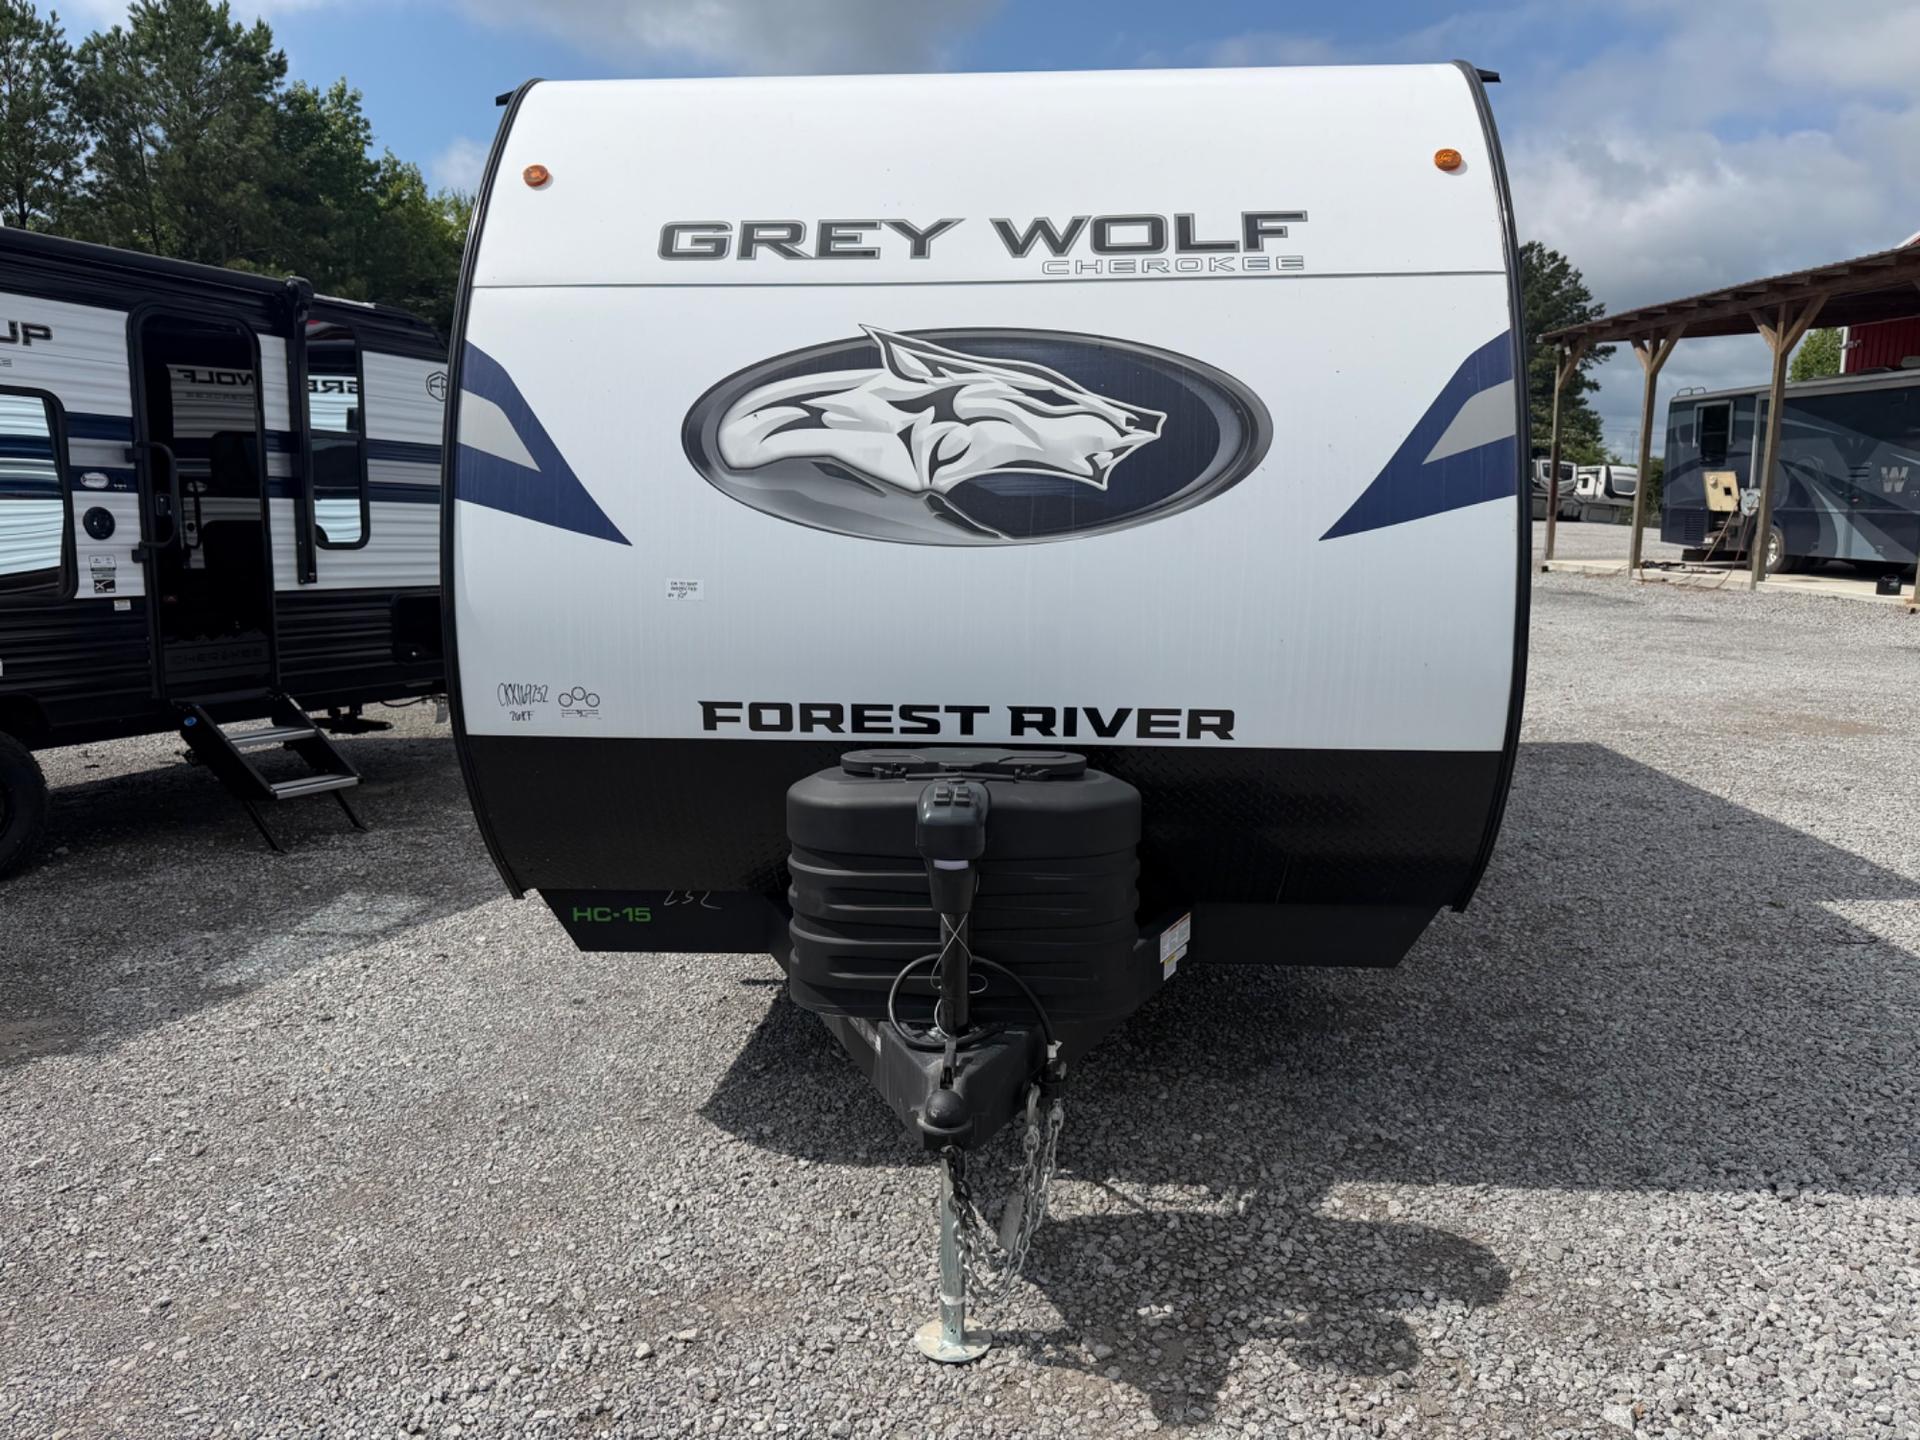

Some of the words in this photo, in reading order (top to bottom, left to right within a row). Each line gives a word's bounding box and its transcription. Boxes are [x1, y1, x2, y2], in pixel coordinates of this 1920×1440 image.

[657, 218, 966, 261] GREY
[989, 210, 1308, 259] WOLF
[1042, 255, 1304, 275] CHEROKEE
[698, 700, 990, 736] FOREST
[1007, 705, 1235, 741] RIVER
[572, 906, 652, 922] HC-15
